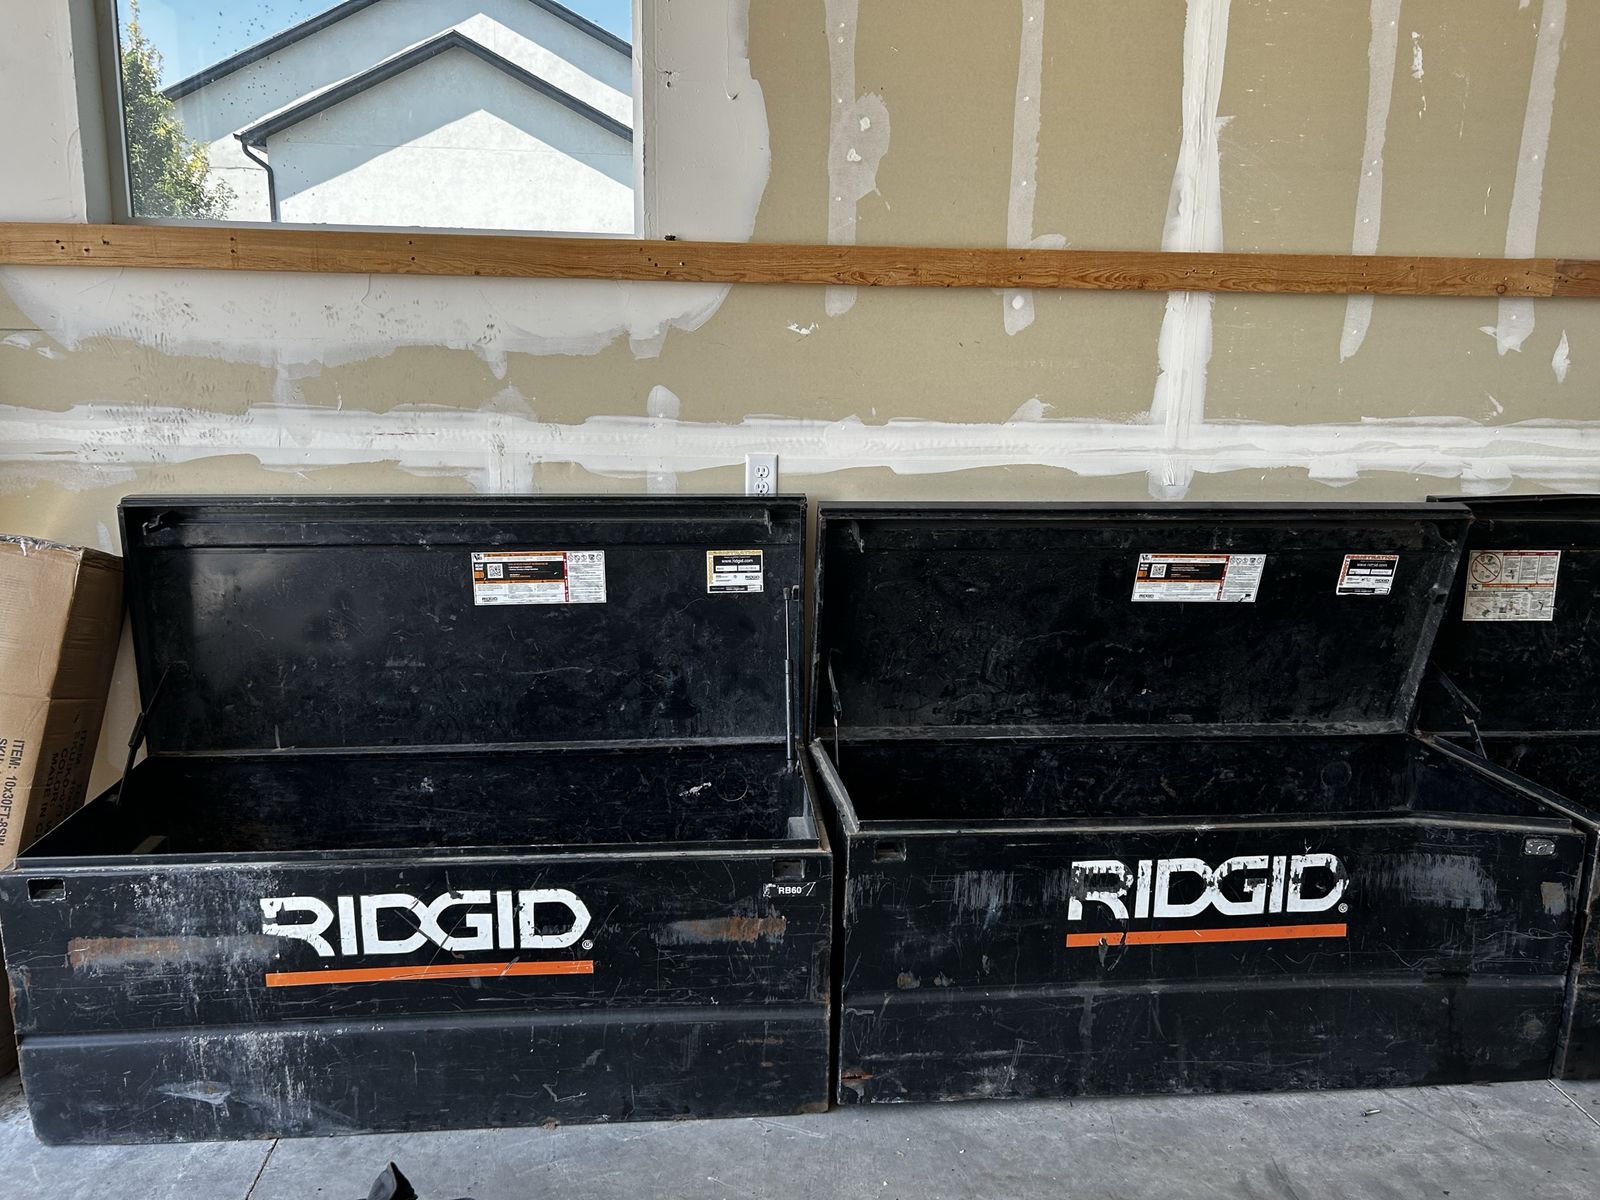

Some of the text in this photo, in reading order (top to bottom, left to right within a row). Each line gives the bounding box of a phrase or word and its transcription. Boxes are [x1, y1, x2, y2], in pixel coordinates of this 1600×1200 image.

[8, 740, 25, 769] ITEM:
[778, 886, 802, 895] RB60
[1067, 853, 1349, 920] RIDGID
[260, 889, 592, 957] RIDGID
